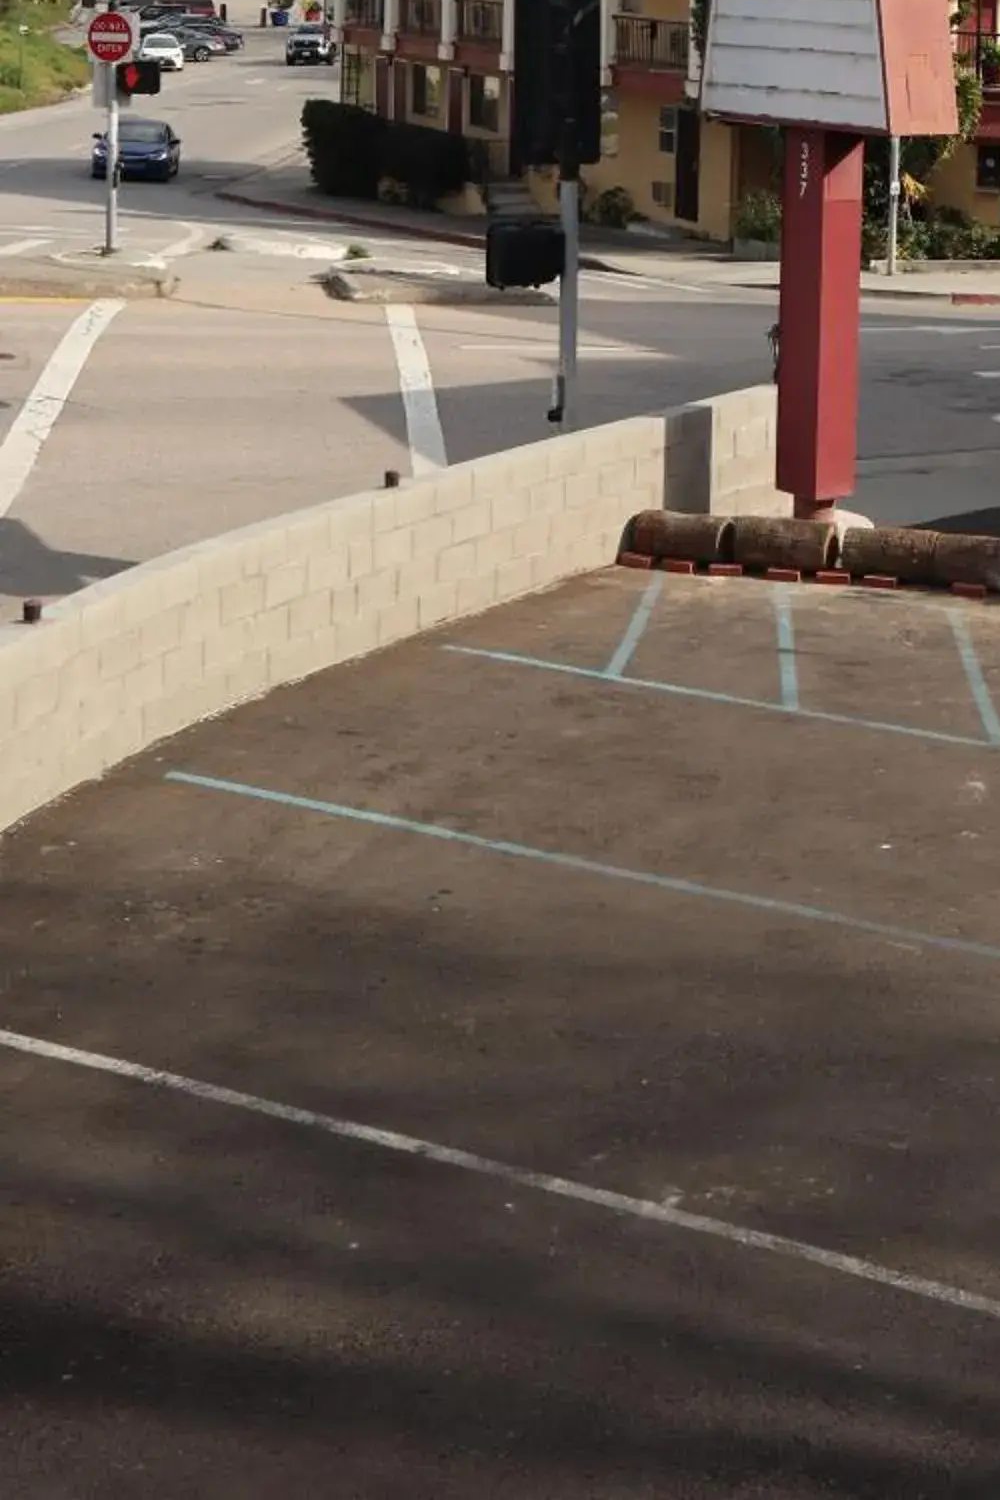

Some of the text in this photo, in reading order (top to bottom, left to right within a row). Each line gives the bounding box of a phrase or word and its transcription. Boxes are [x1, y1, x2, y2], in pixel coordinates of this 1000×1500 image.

[94, 21, 126, 31] DO NOT
[97, 44, 123, 53] ENTER
